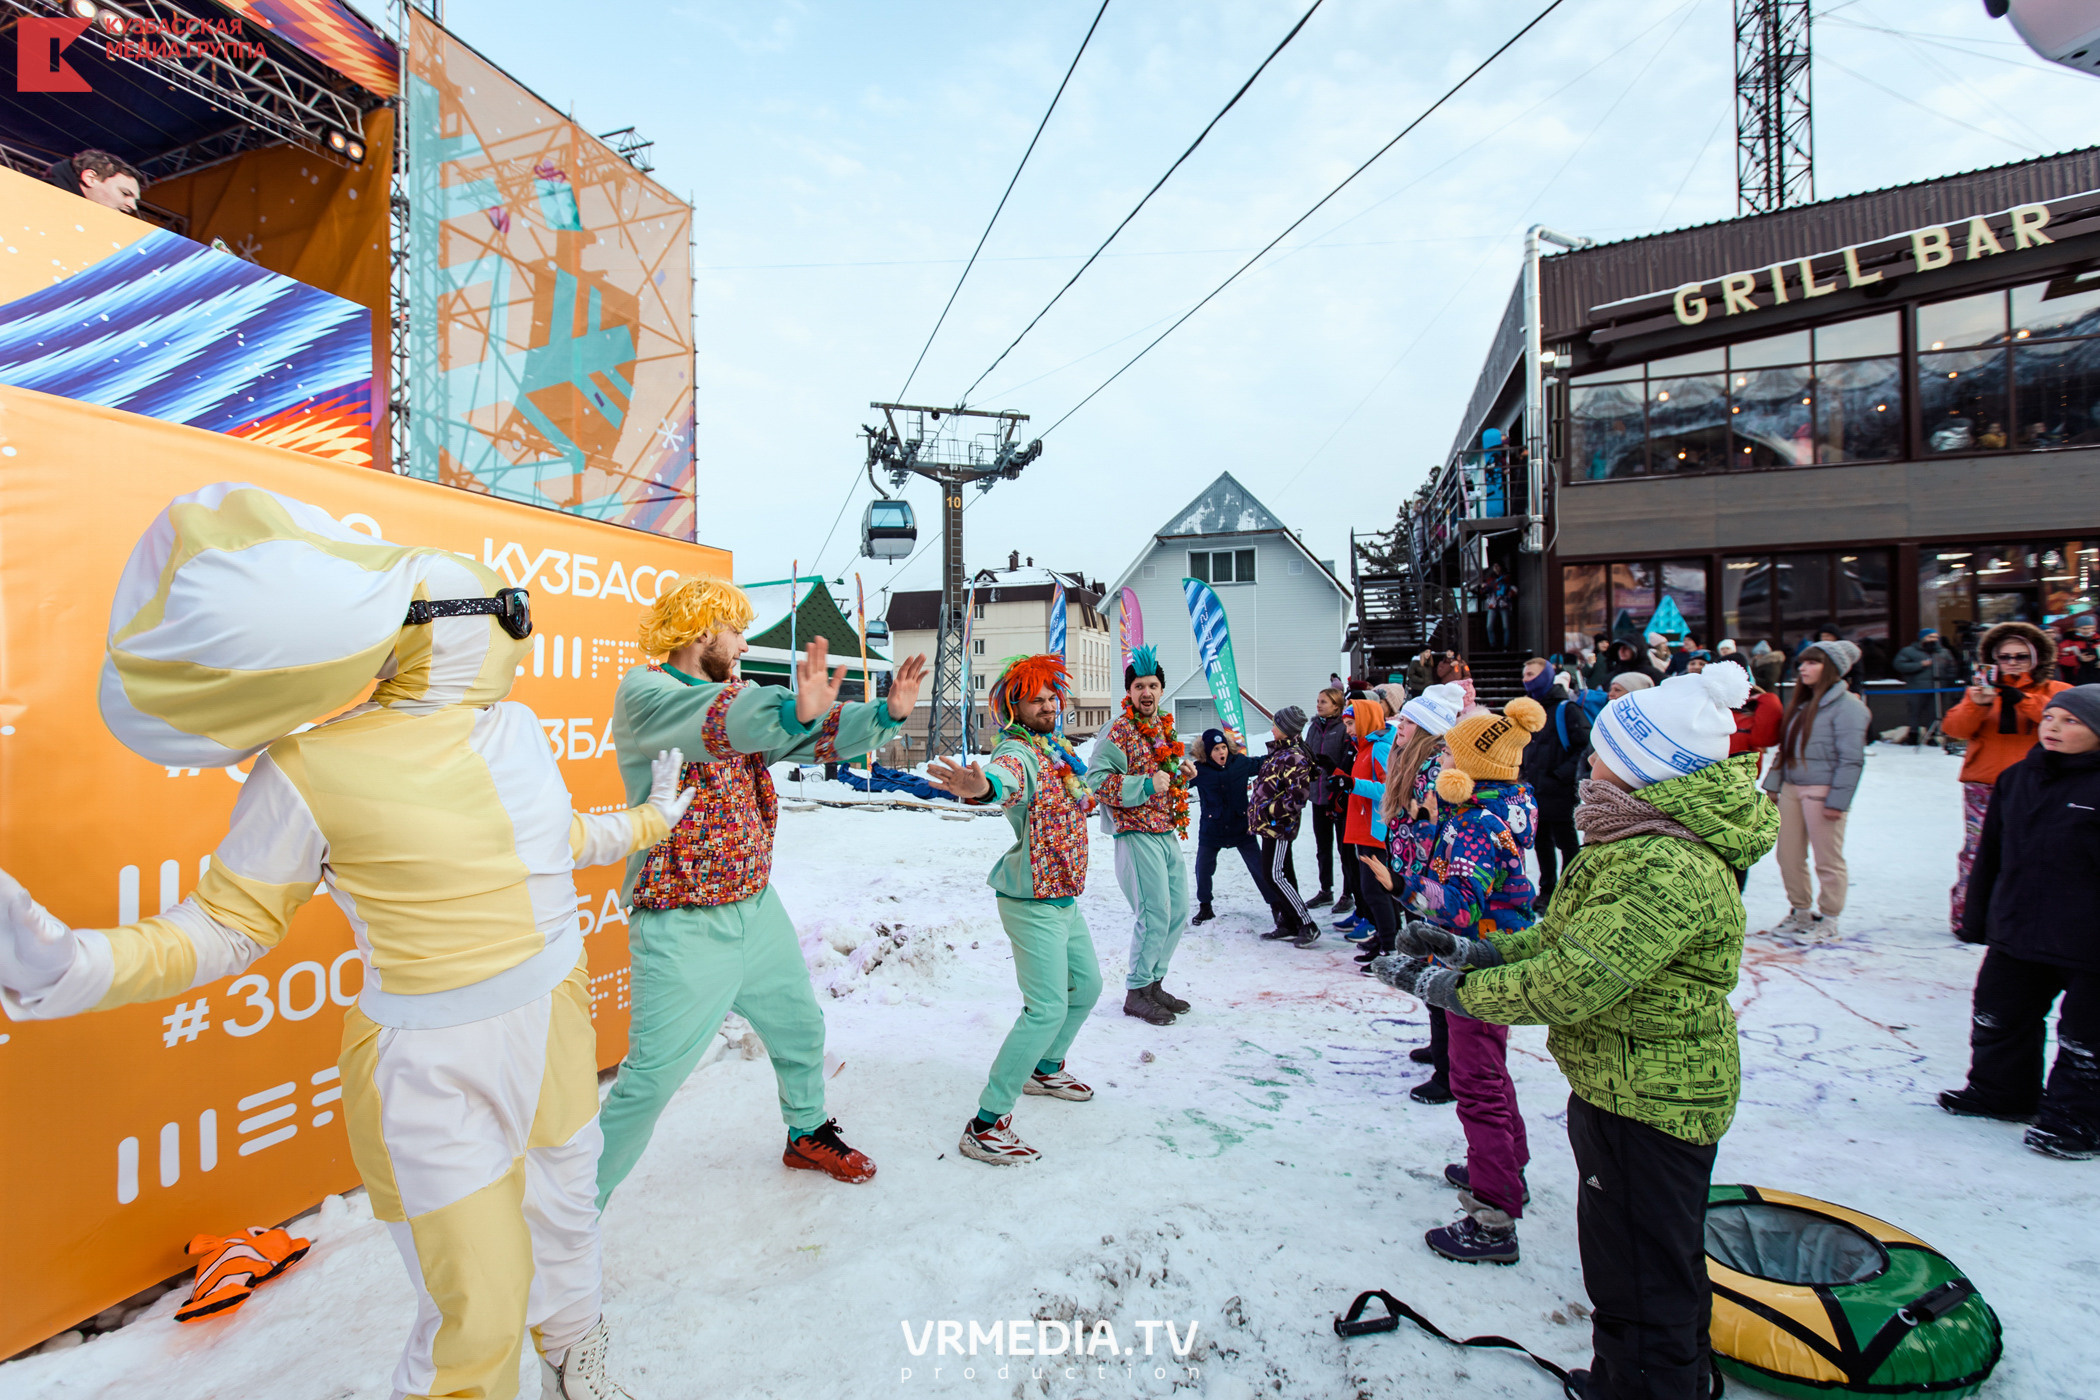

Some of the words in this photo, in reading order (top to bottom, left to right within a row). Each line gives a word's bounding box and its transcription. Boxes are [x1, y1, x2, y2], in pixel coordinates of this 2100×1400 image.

[1672, 248, 1885, 326] GRILL
[1910, 204, 2056, 273] BAR
[946, 496, 962, 509] 10
